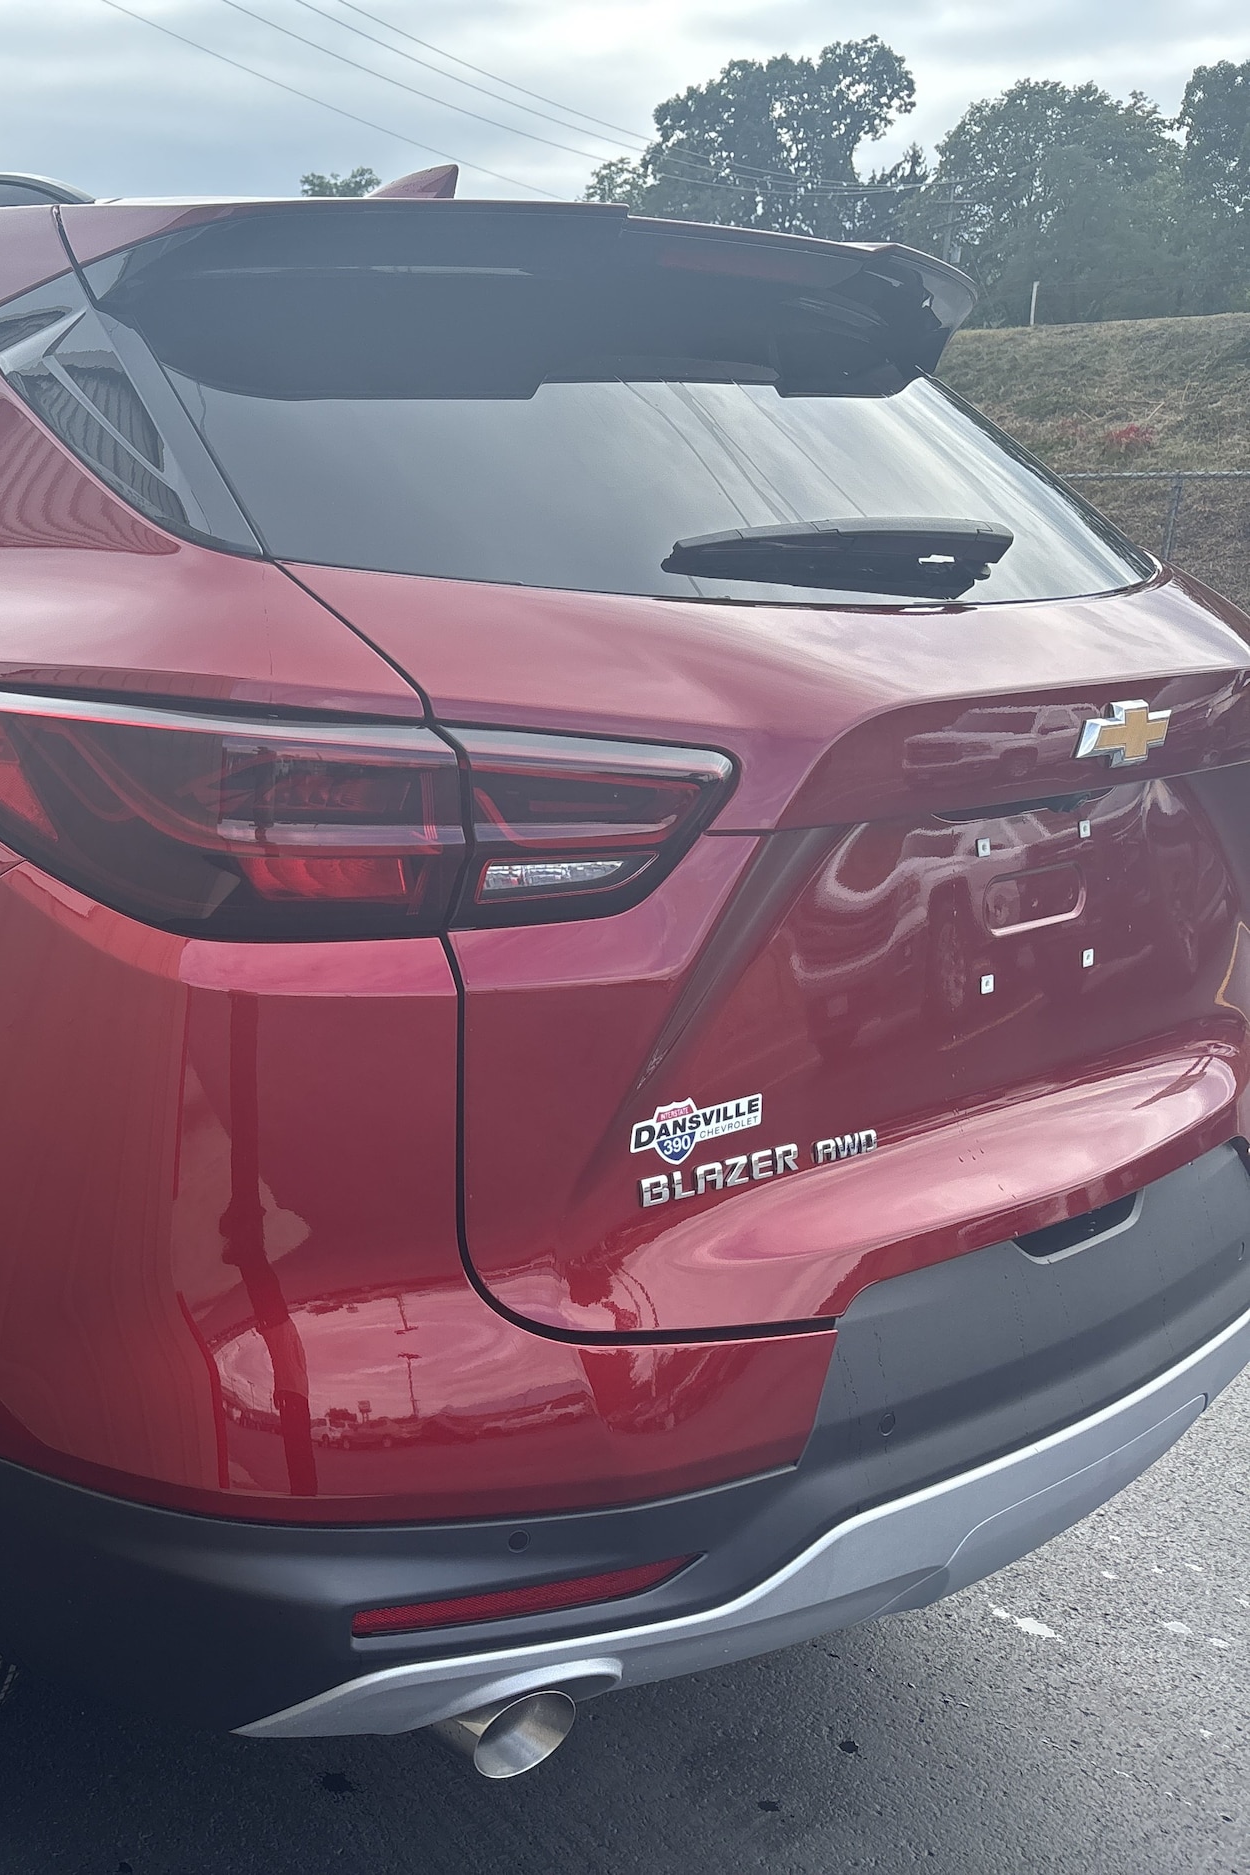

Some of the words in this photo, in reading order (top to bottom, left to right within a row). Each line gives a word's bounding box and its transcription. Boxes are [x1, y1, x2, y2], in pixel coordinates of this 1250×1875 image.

[633, 1097, 760, 1149] DANSVILLE
[659, 1106, 690, 1121] INTERSTATE
[663, 1135, 691, 1155] 390
[700, 1115, 758, 1139] CHEVROLET
[639, 1143, 799, 1208] BLAZER
[811, 1129, 878, 1164] AWD
